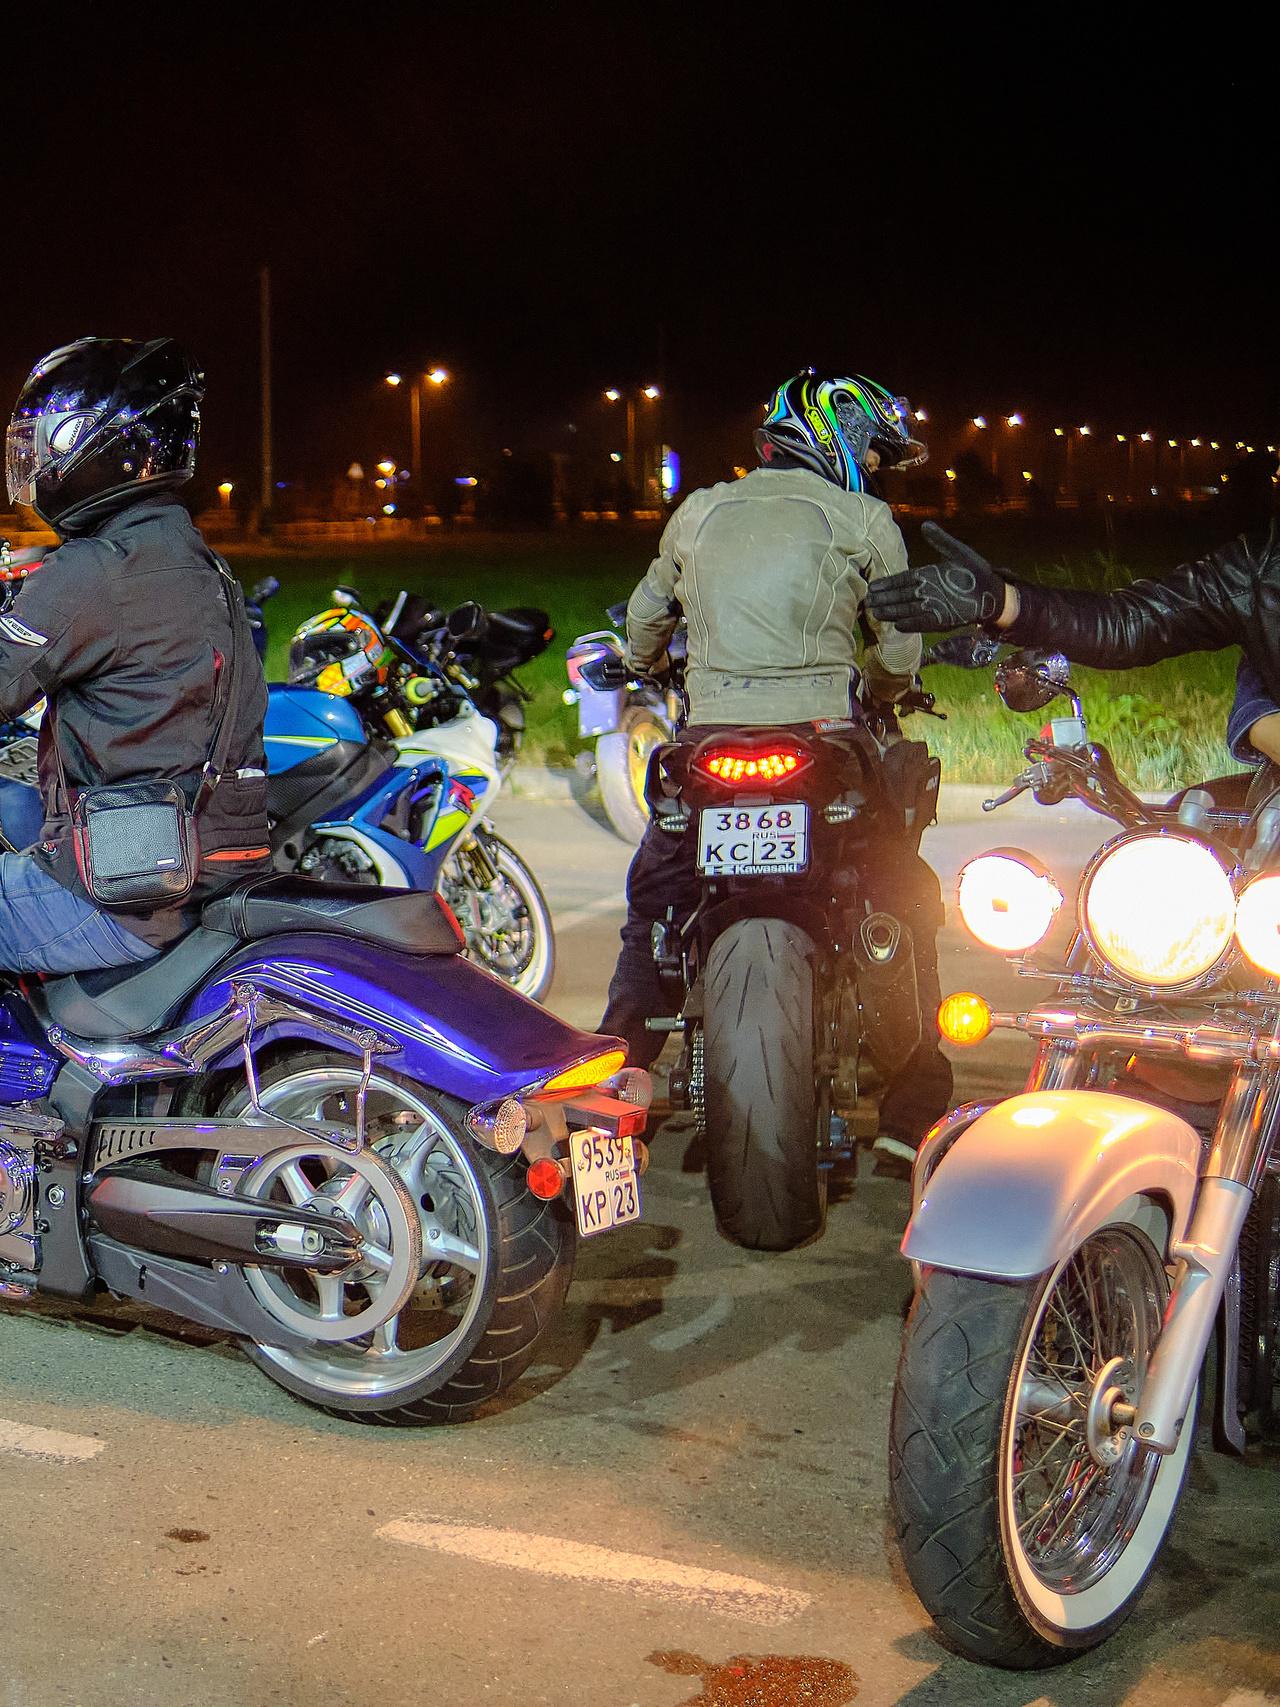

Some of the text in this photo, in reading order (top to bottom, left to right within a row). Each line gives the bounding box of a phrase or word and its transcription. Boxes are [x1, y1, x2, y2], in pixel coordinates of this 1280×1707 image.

[68, 418, 82, 446] SHARK
[716, 810, 792, 831] 3868
[752, 831, 777, 840] RUS
[760, 841, 796, 860] 23
[735, 863, 798, 875] Kawasaki
[582, 1136, 624, 1172] 9539
[605, 1169, 620, 1182] RUS
[614, 1181, 635, 1219] 23
